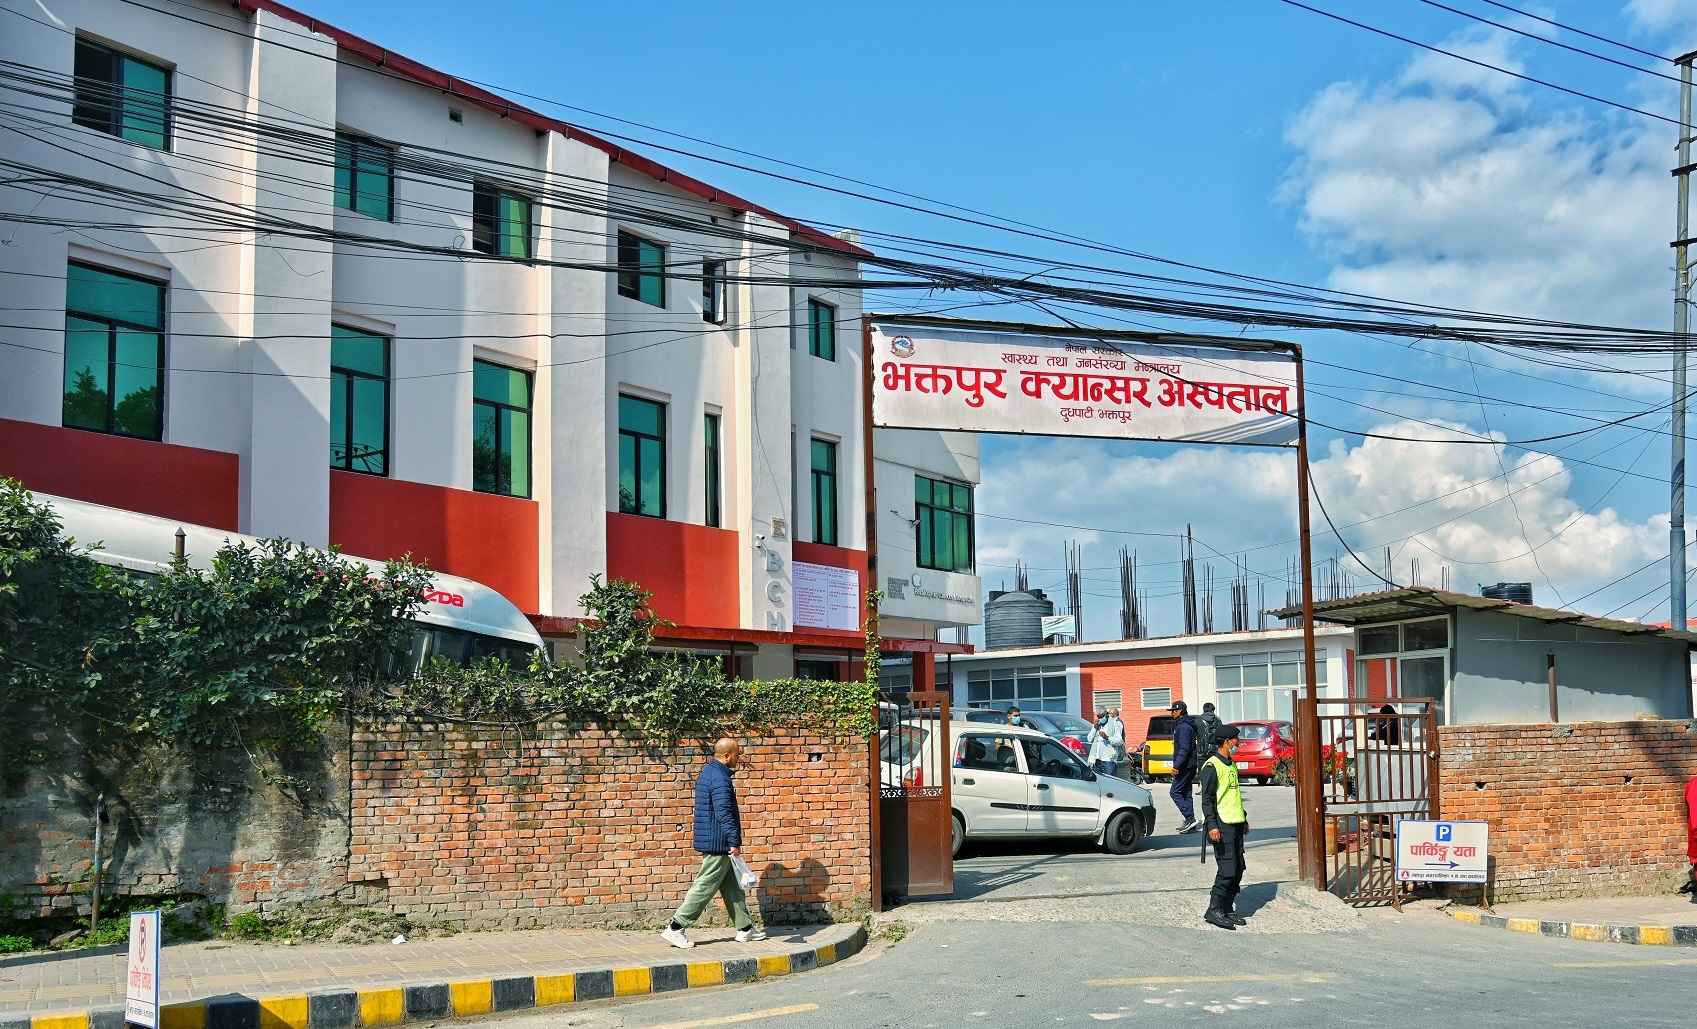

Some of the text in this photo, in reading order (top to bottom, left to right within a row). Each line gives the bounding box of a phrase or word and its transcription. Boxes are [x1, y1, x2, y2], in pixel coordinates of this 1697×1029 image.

[1065, 343, 1123, 357] नेपाल सरकार
[1001, 353, 1039, 366] स्वास्थ्य
[1046, 355, 1068, 367] तथा
[882, 361, 1290, 415] भक्तपुर क्यान्सर अस्पताल
[1098, 408, 1132, 423] भक्तपुर
[1440, 826, 1449, 839] P
[1453, 846, 1477, 857] यता
